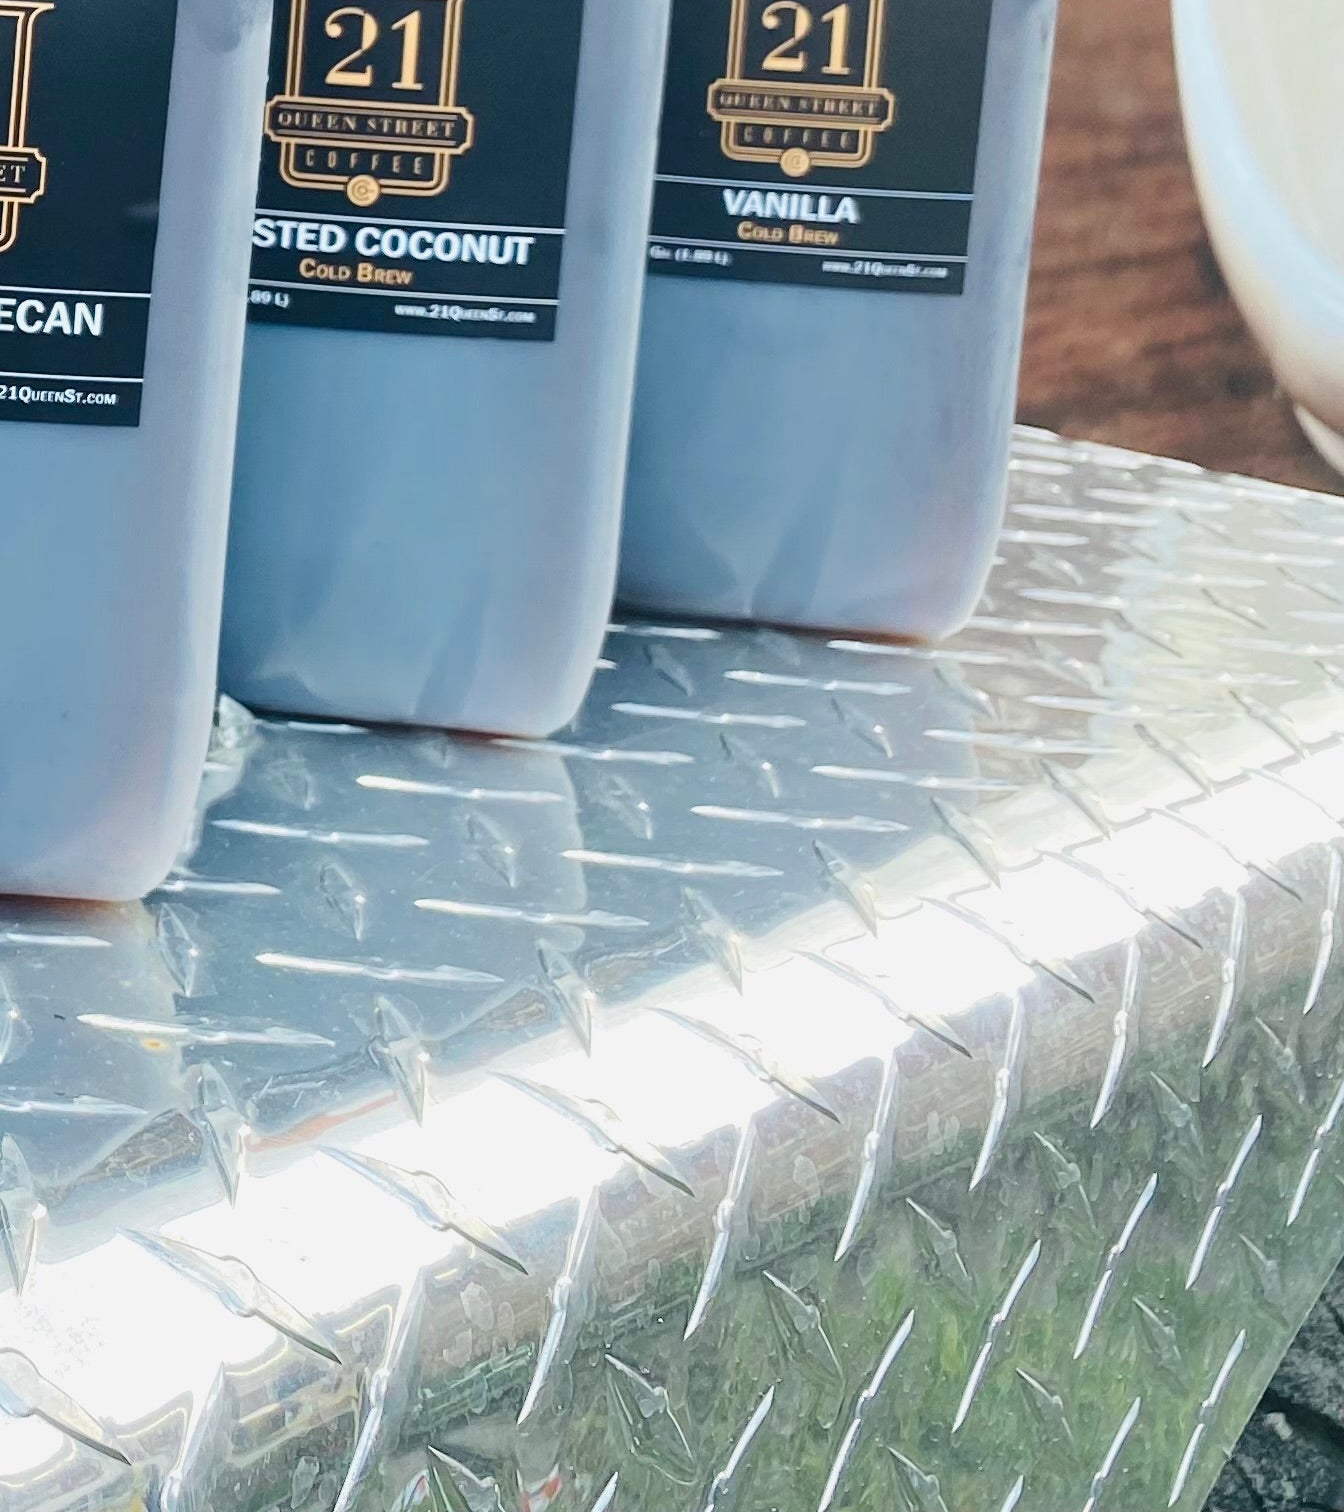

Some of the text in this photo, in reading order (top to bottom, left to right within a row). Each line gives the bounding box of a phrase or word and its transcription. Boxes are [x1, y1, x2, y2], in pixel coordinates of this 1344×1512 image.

[324, 6, 424, 91] 21
[761, 0, 852, 75] 21
[278, 111, 456, 138] QUEEN STREET
[306, 149, 423, 175] COFFEE
[723, 188, 860, 224] VANILLA
[252, 218, 535, 265] STED COCONUT
